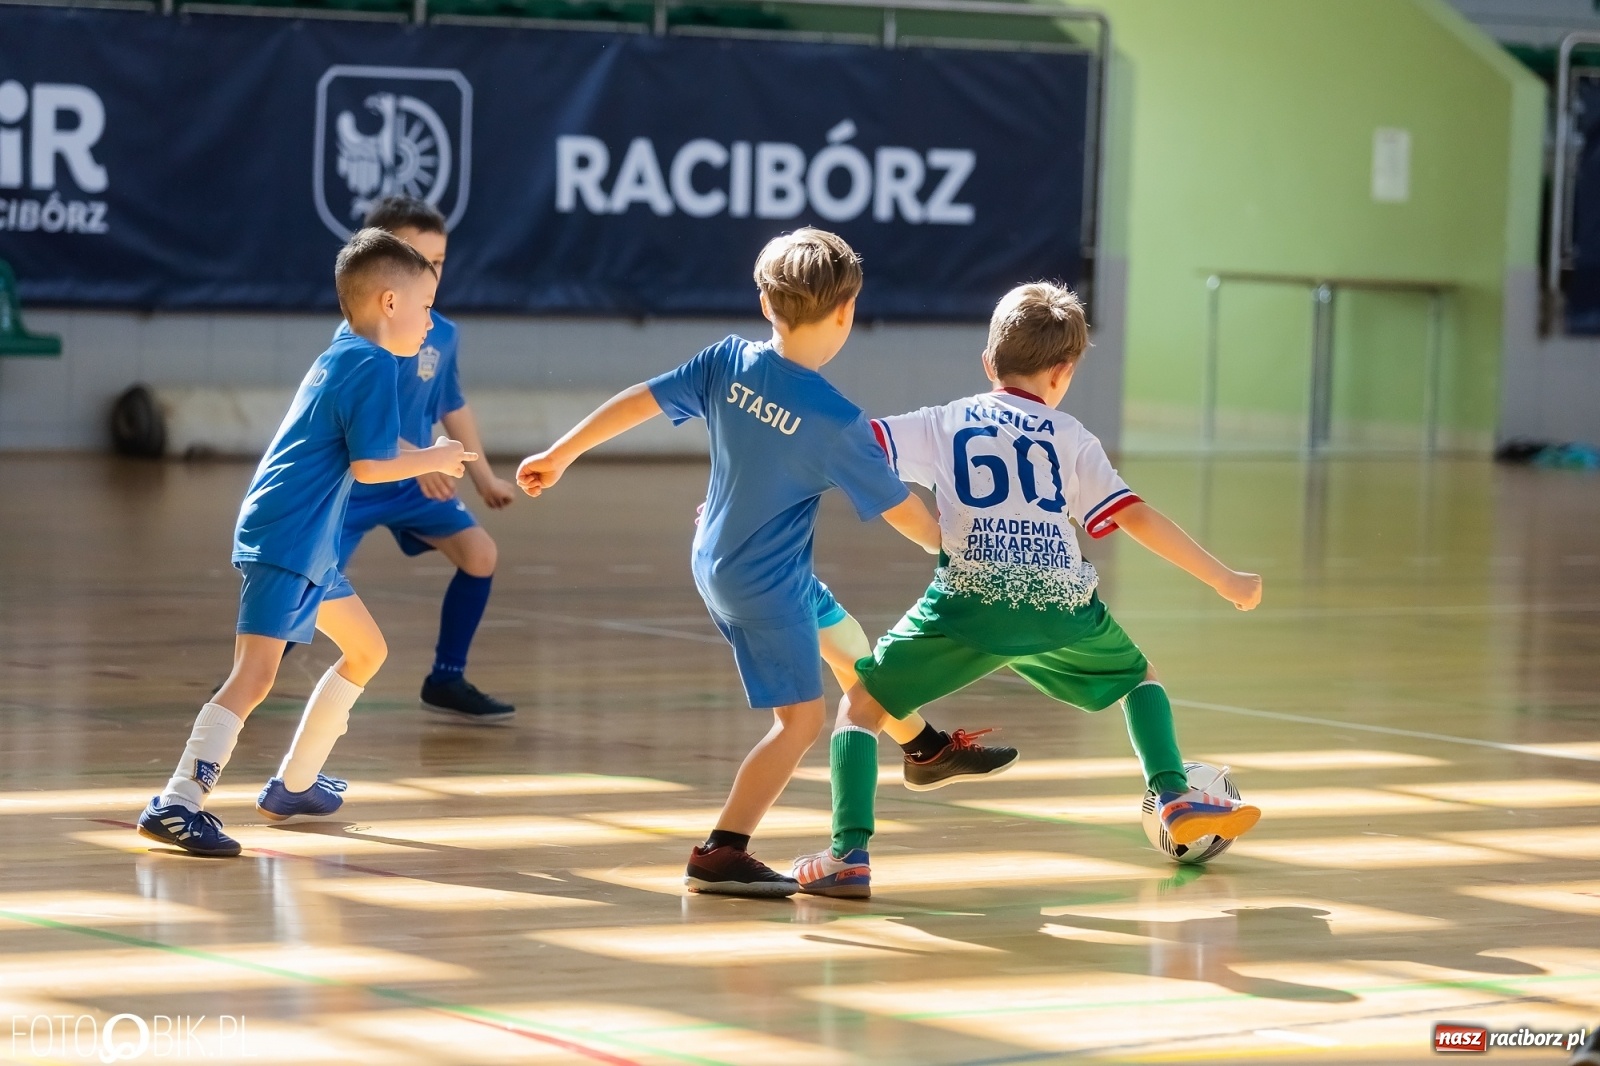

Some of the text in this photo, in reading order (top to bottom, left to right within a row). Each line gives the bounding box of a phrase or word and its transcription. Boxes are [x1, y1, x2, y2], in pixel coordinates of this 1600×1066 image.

[555, 118, 977, 225] RACIBÓRZ
[726, 382, 802, 435] STASIU
[965, 405, 1054, 436] KUBICA
[953, 425, 1066, 513] 60
[967, 533, 1067, 556] PIŁKARSKA
[971, 517, 1062, 539] AKADEMIA
